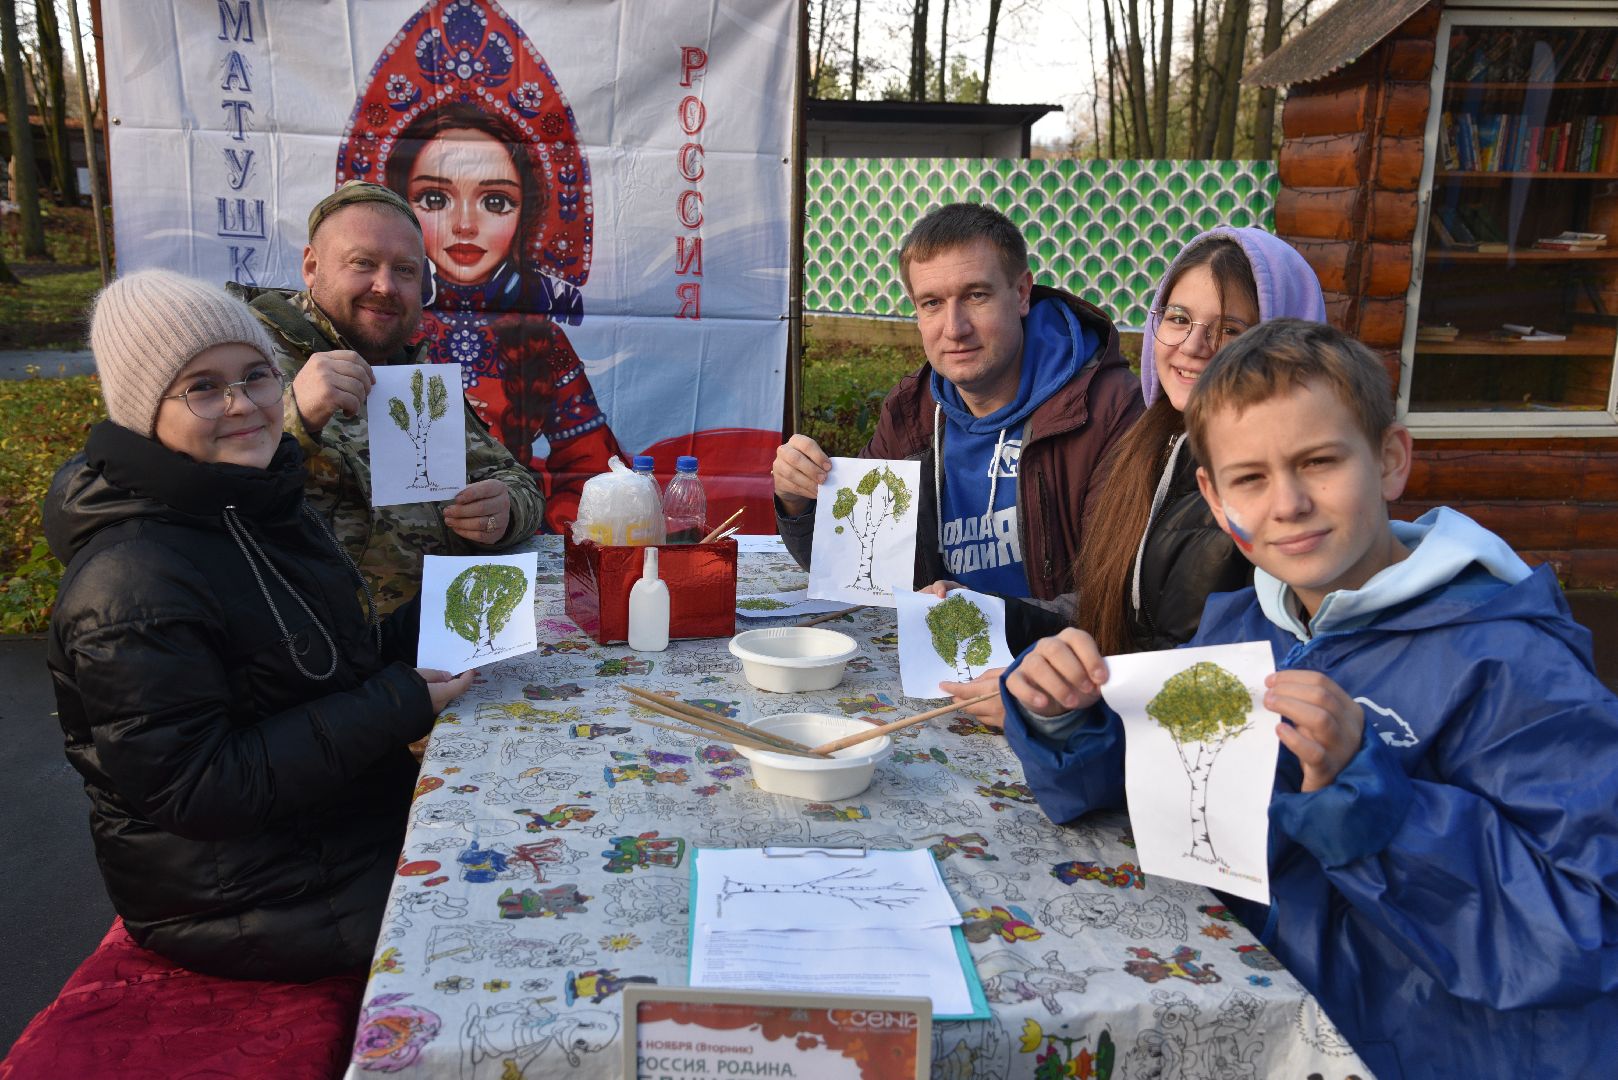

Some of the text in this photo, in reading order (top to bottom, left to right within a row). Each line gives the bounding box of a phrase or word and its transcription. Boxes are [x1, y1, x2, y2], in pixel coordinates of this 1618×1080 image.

[217, 0, 266, 287] МАТУШК
[674, 46, 708, 320] РОССИЯ
[637, 1056, 798, 1078] РОССИЯ. РОДИНА.
[646, 1040, 693, 1051] НОЯБРЯ
